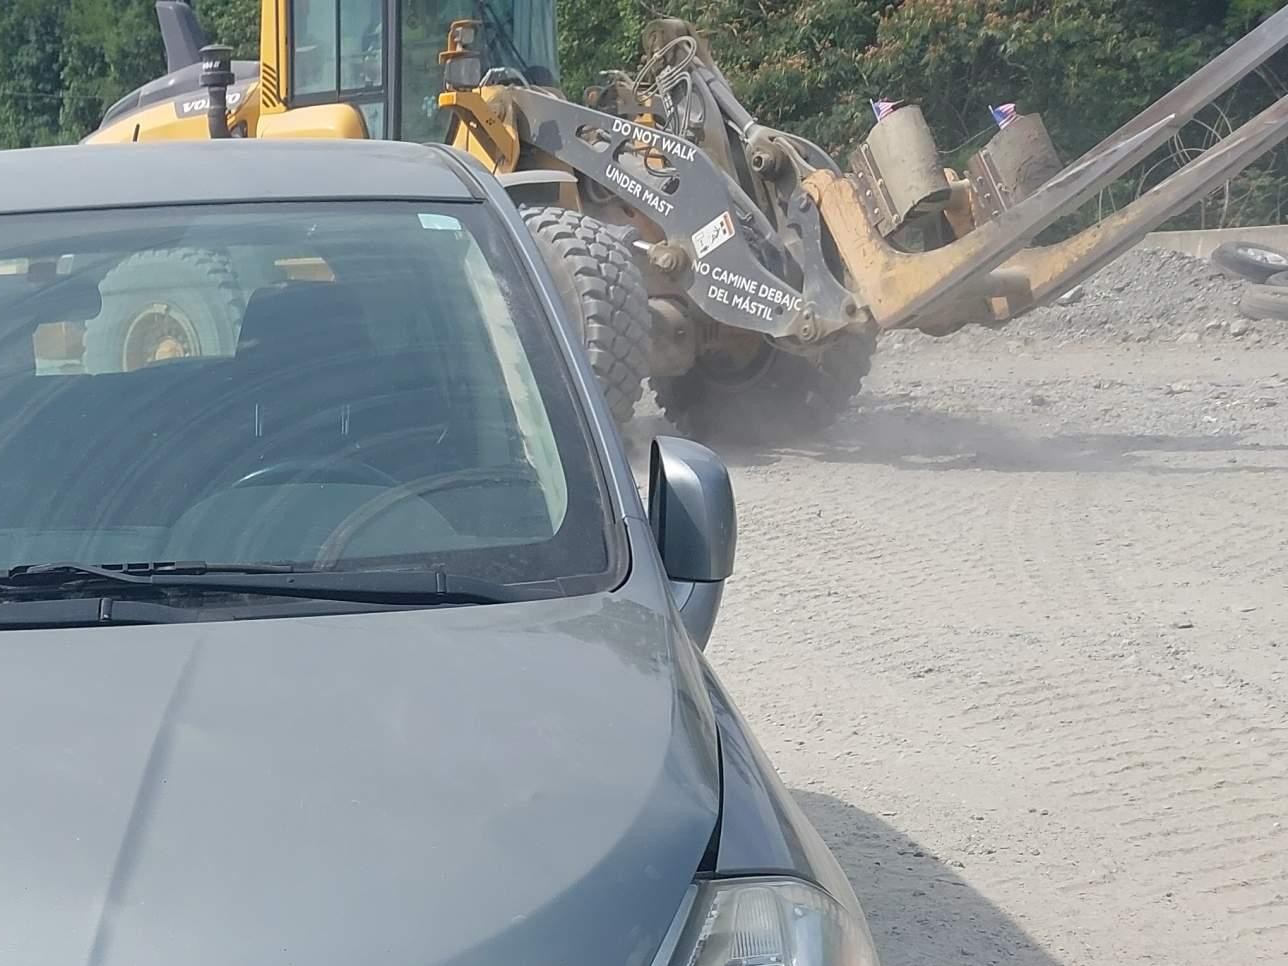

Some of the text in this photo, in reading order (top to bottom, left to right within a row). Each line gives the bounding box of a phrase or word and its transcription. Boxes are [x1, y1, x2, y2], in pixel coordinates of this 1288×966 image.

[612, 119, 697, 162] DO NOT WALK
[605, 164, 674, 217] UNDER MAST
[691, 259, 710, 275] NO
[711, 267, 758, 294] CAMINE
[708, 285, 773, 321] DEL MÁSTIL
